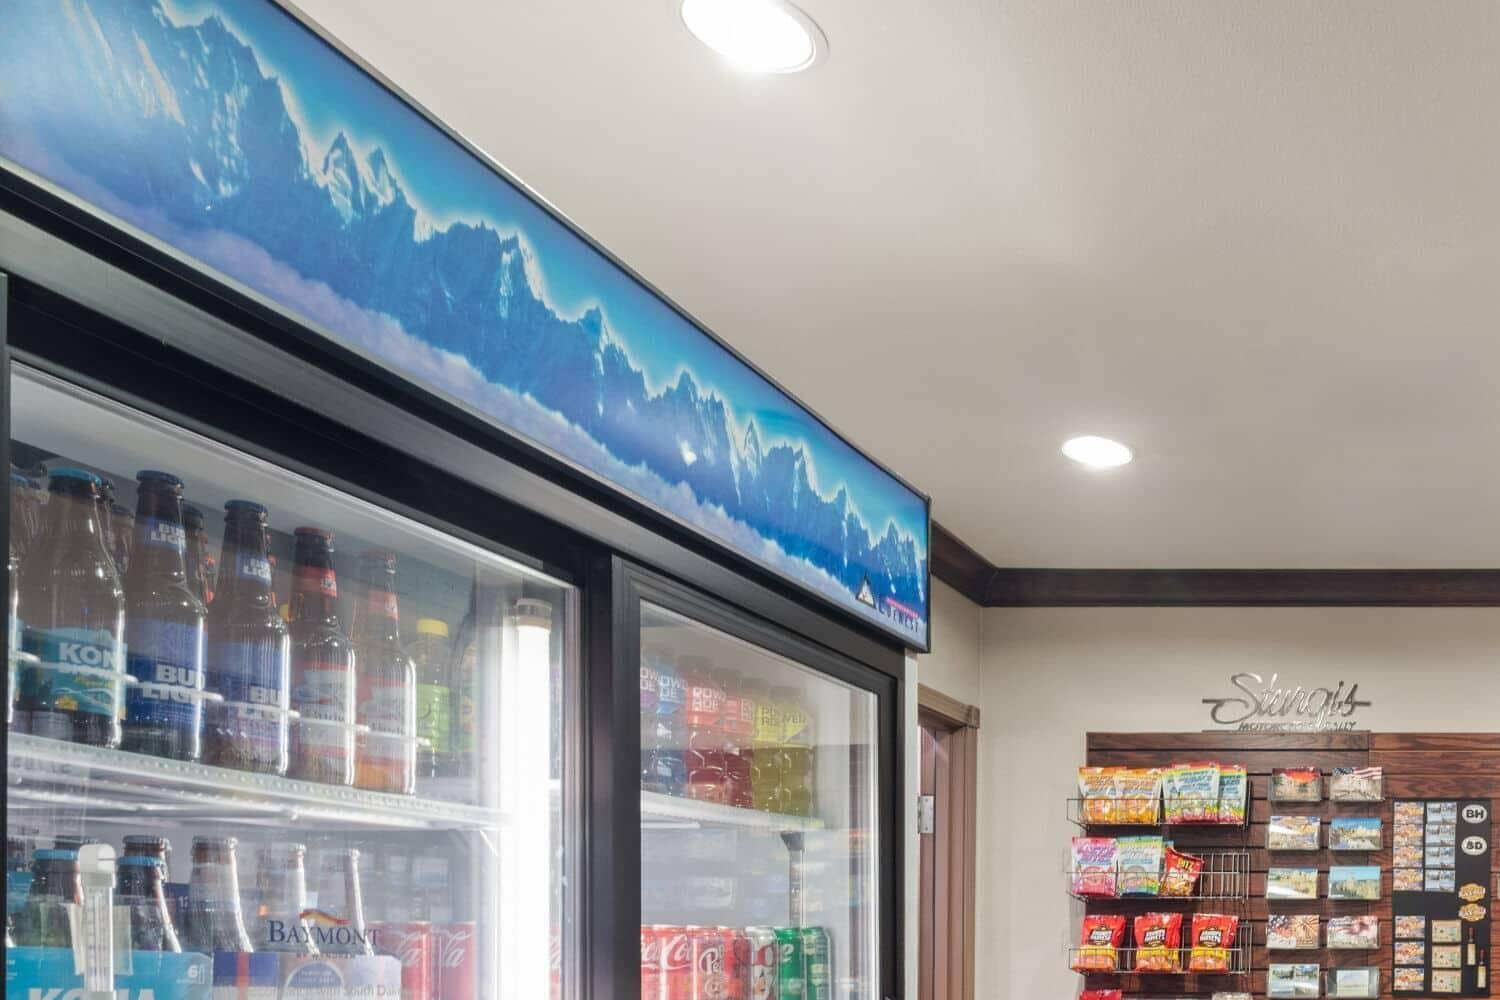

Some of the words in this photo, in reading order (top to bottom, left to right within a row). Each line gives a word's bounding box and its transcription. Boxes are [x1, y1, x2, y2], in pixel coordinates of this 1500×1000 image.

[1465, 809, 1484, 819] BH
[268, 920, 382, 946] BAYMONT
[344, 985, 375, 997] South
